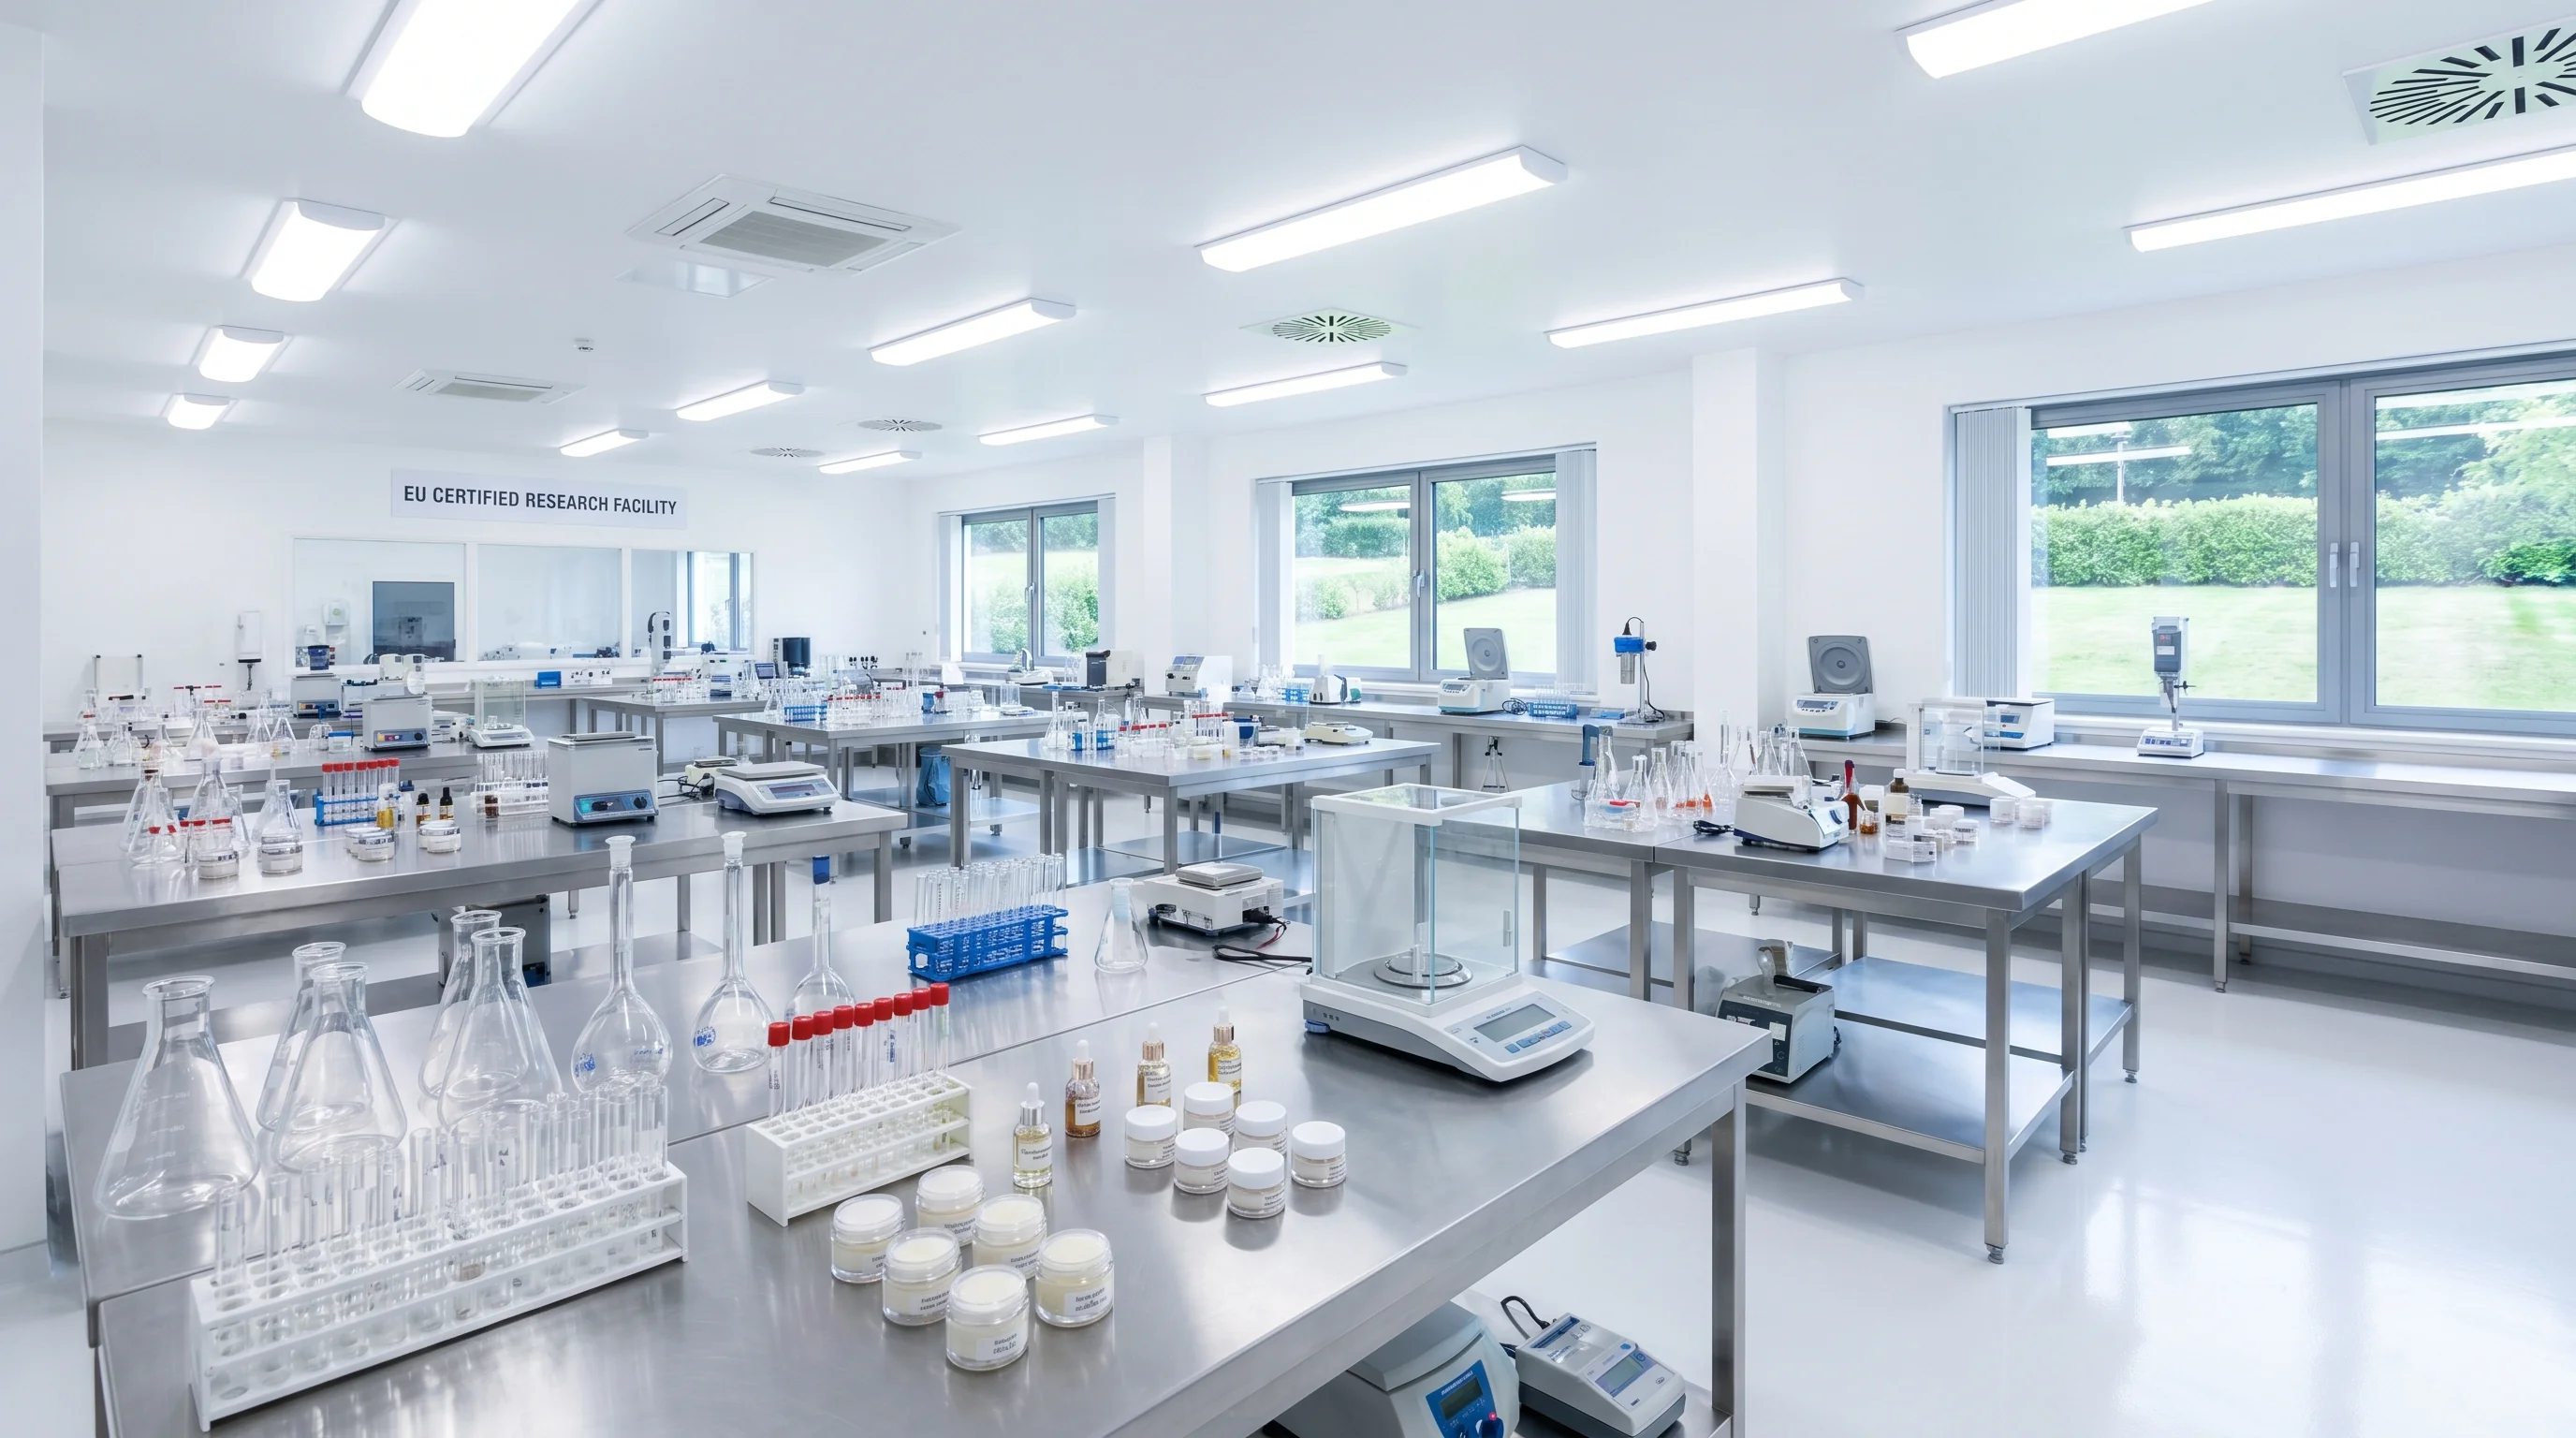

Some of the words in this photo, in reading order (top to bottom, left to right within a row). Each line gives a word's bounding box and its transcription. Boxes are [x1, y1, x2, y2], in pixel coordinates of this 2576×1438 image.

[404, 485, 426, 502] EU
[432, 487, 520, 506] CERTIFIED
[525, 492, 608, 511] RESEARCH
[614, 497, 677, 515] FACILITY
